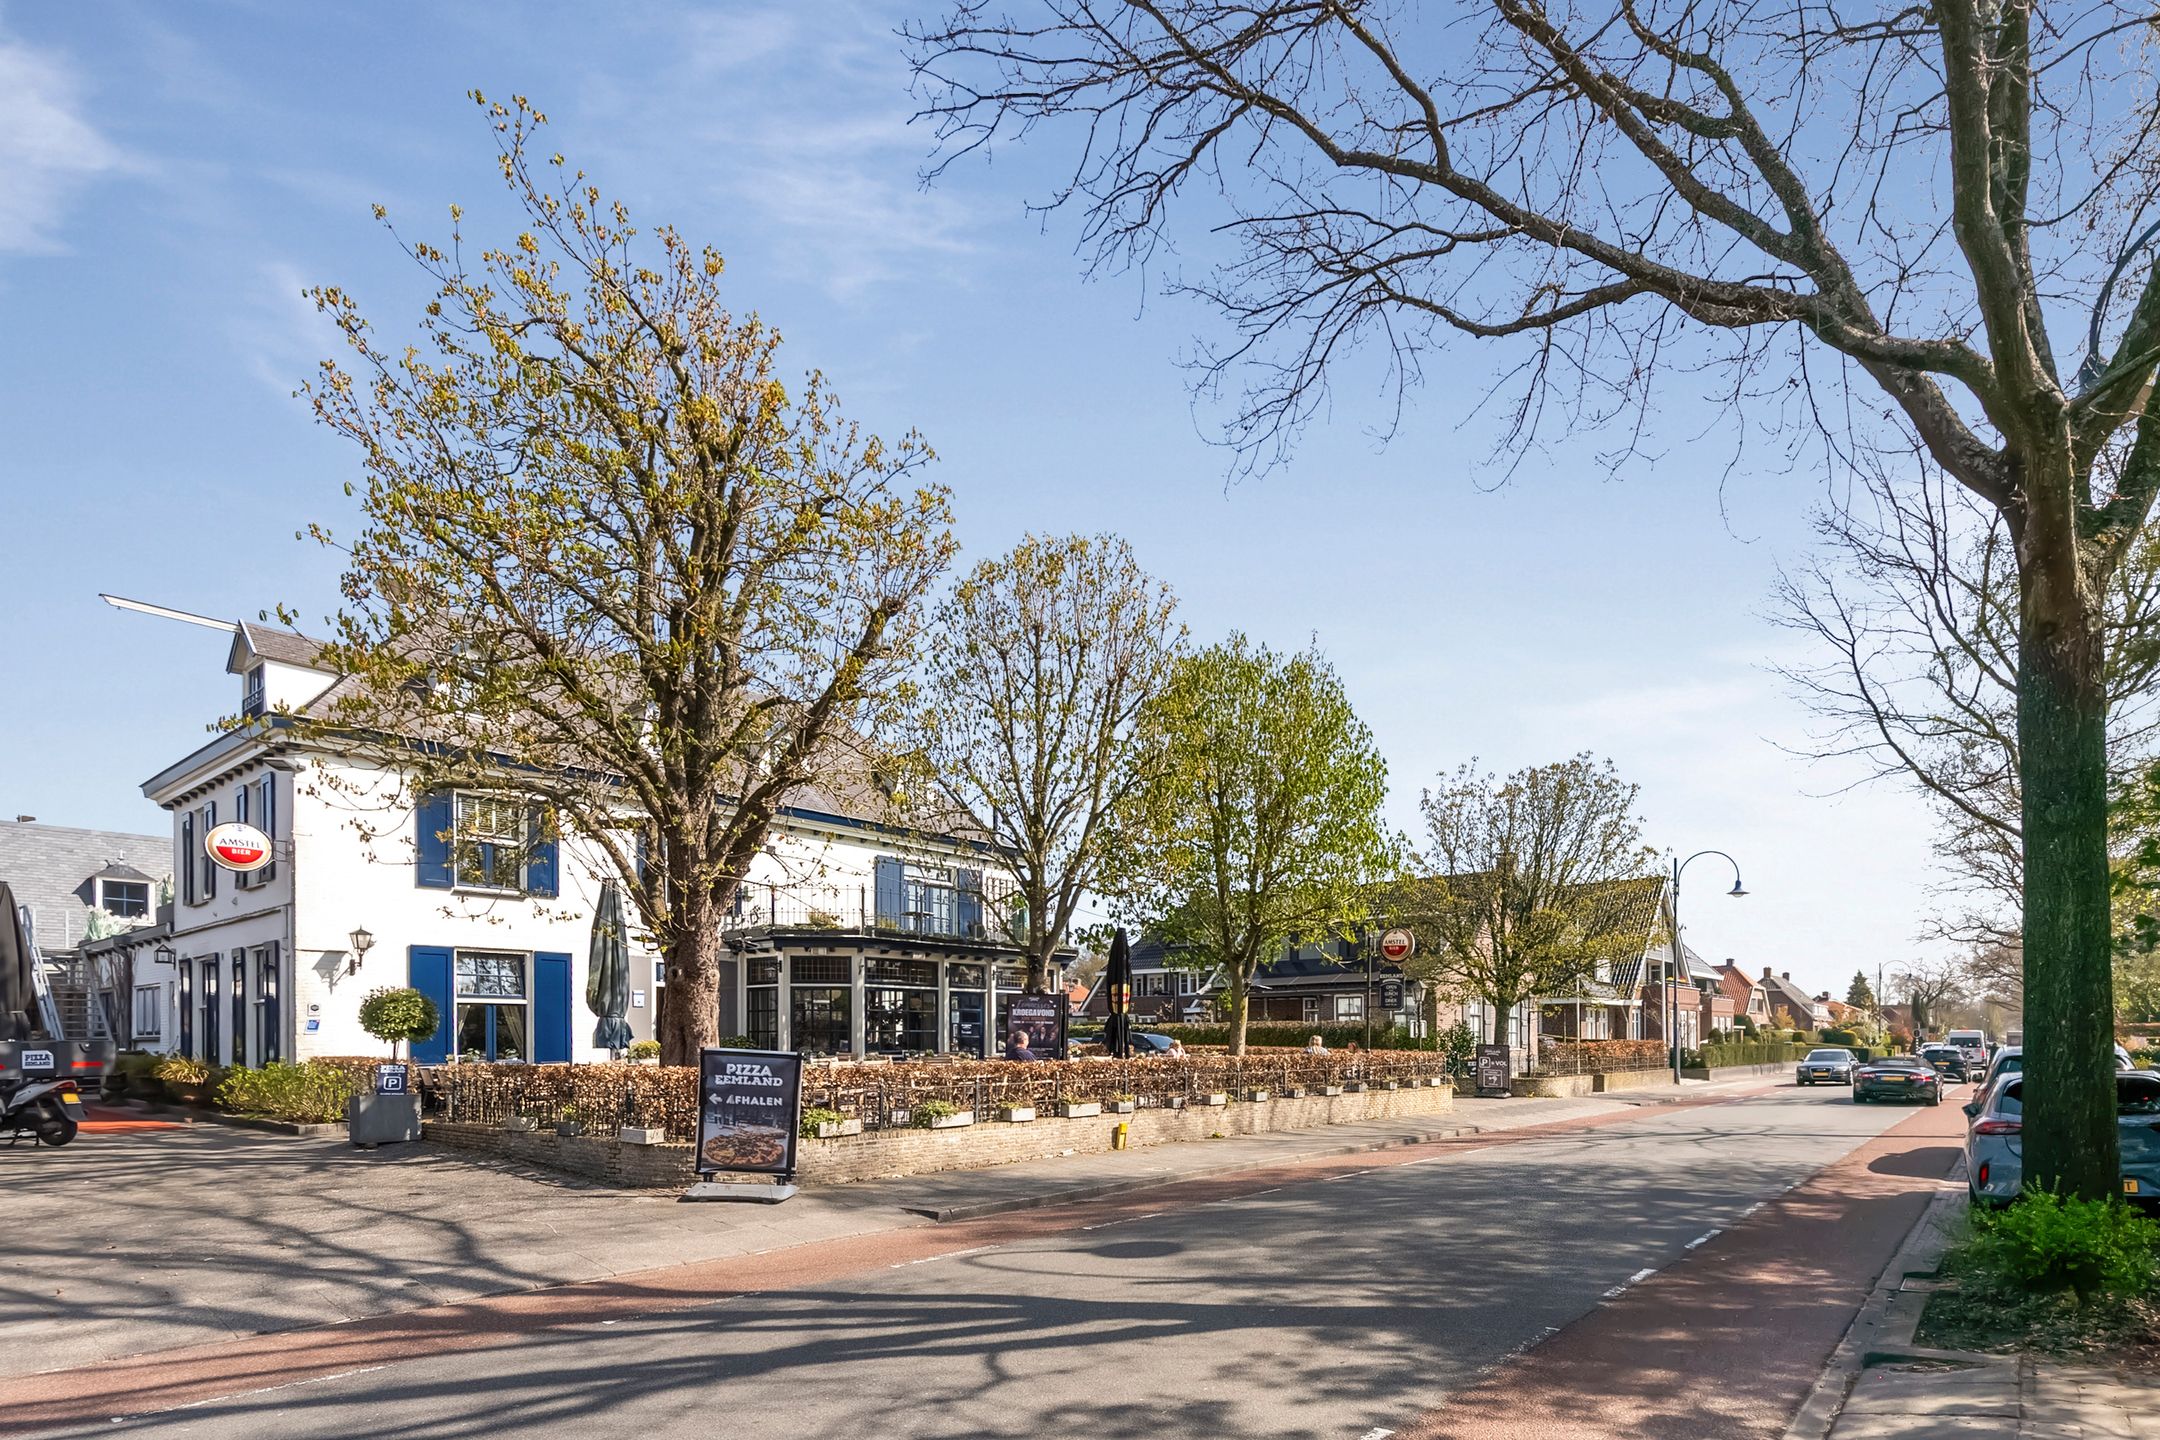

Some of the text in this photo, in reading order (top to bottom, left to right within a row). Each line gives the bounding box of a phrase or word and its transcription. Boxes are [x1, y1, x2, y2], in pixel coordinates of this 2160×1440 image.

[231, 848, 251, 856] BIER
[1012, 1008, 1055, 1017] KROEGAVOND
[726, 1063, 772, 1077] PIZZA
[388, 1079, 398, 1088] P
[714, 1074, 784, 1087] EEMLAND
[725, 1094, 783, 1106] AFHALEN
